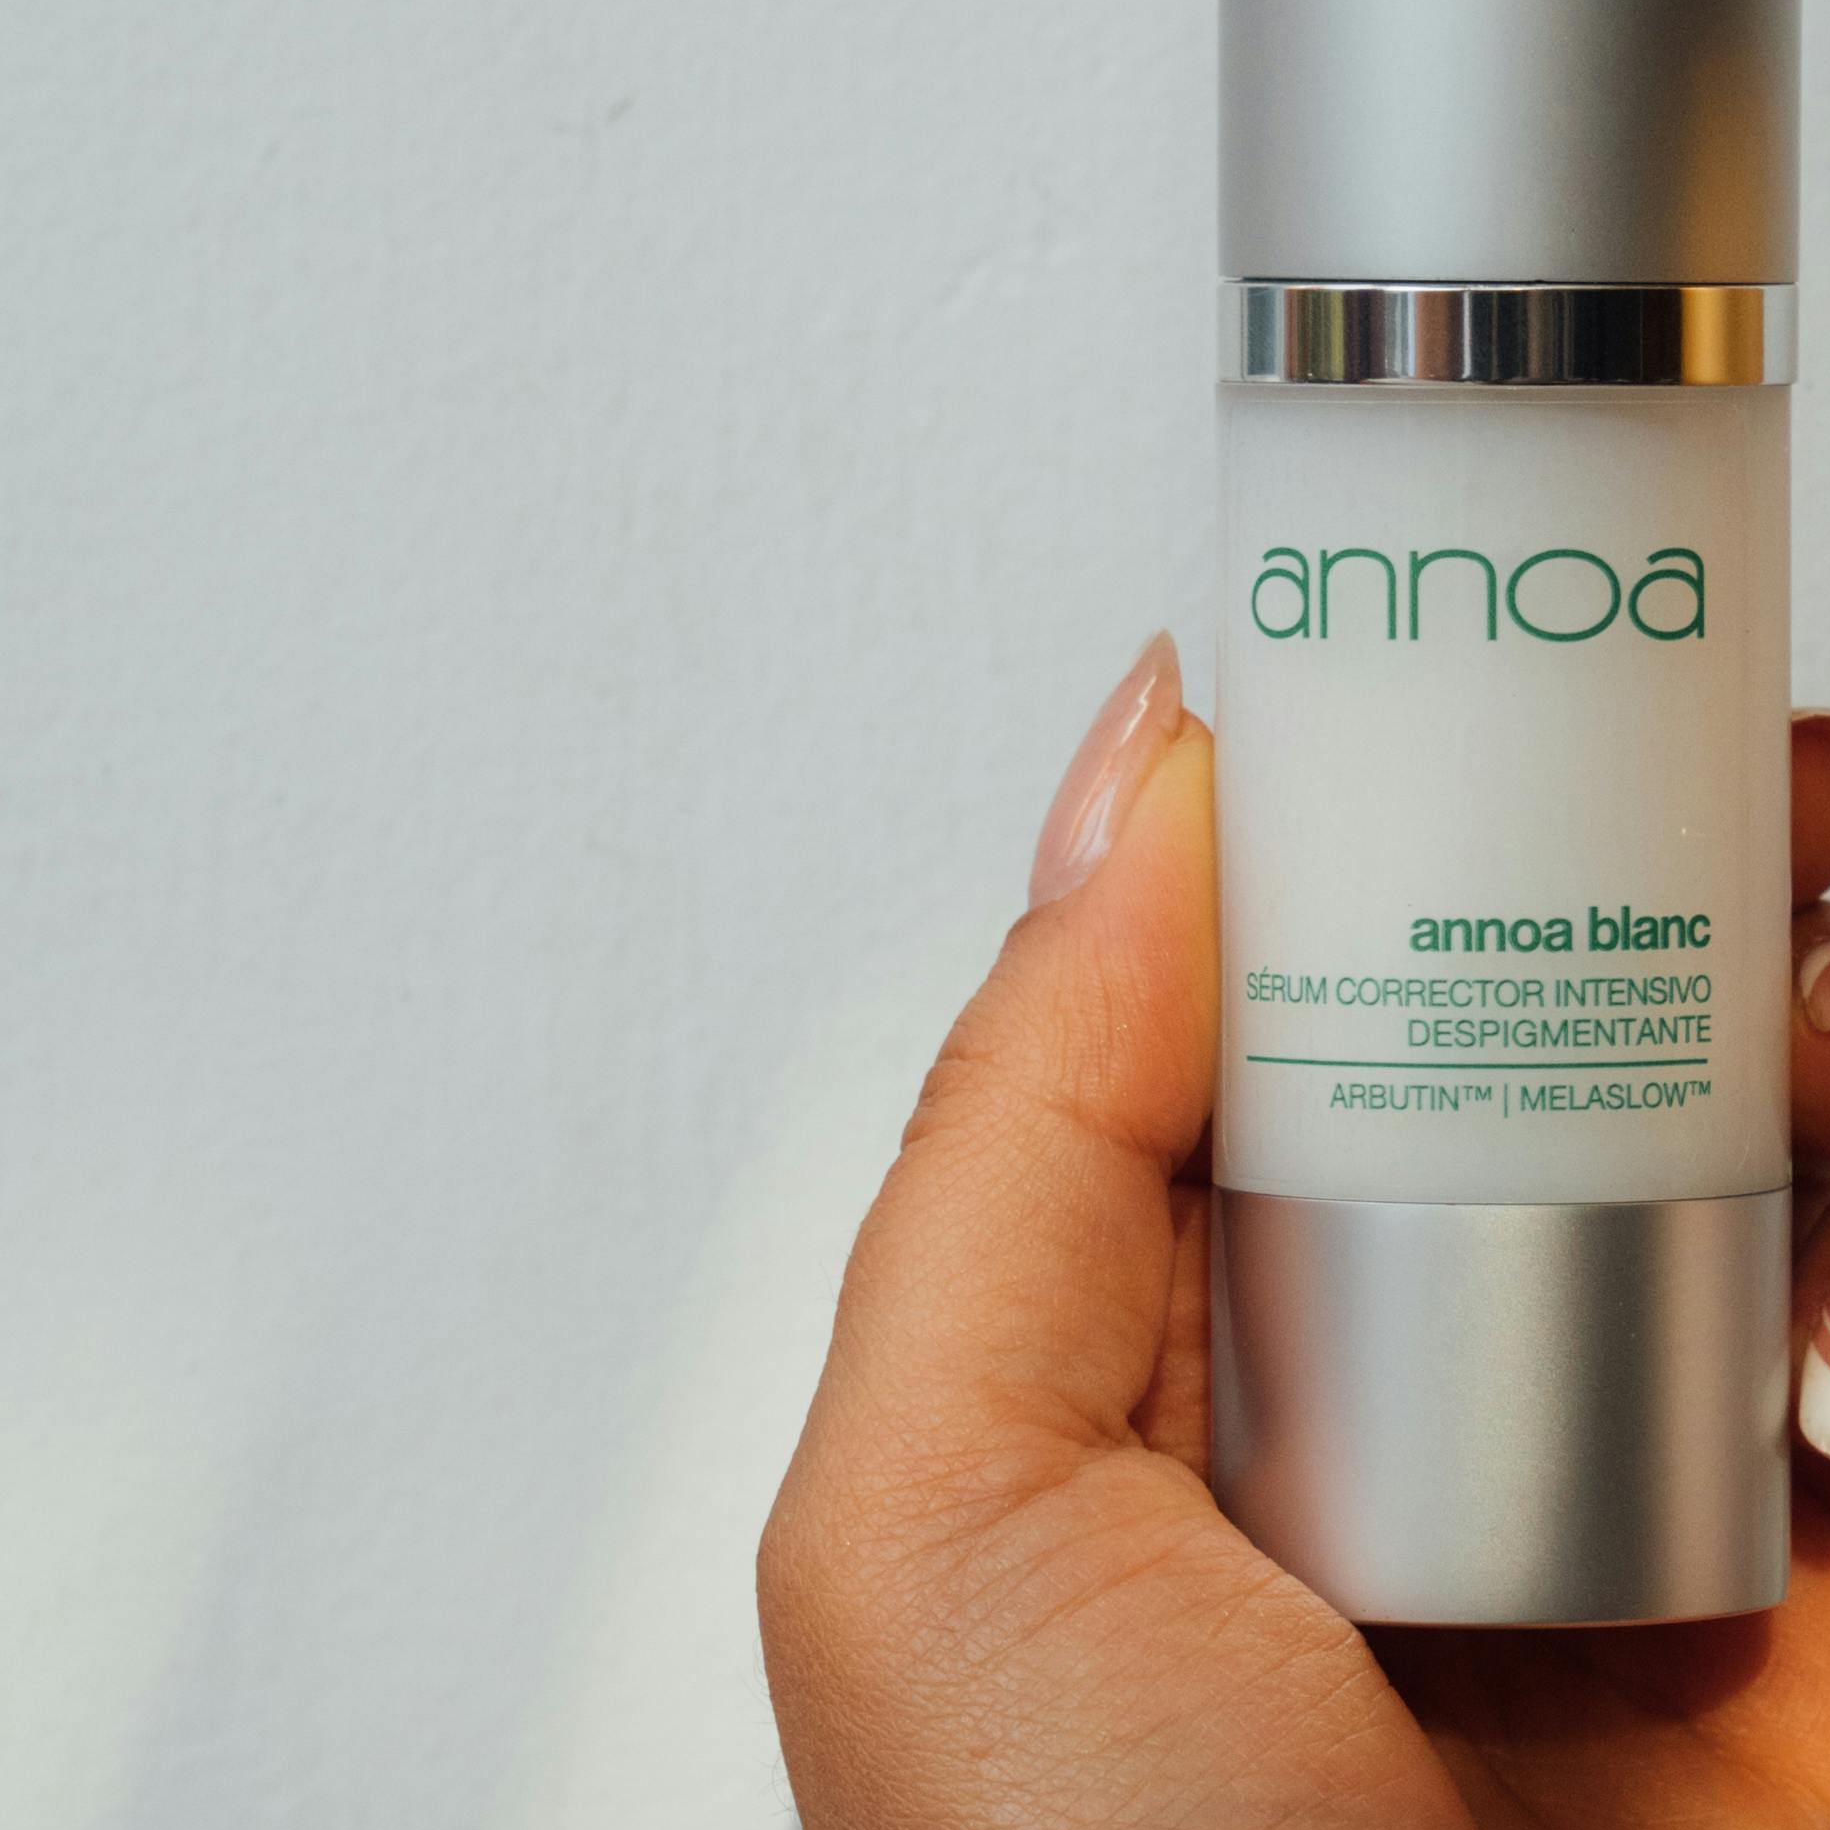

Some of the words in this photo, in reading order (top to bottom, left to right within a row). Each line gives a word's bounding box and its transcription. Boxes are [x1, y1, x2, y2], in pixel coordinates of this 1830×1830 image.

[1251, 547, 1703, 641] annoa
[1409, 916, 1571, 951] annoa
[1588, 906, 1710, 949] blanc
[1246, 966, 1325, 1003] SÉRUM
[1336, 978, 1543, 1007] CORRECTOR
[1554, 974, 1710, 1005] INTENSIVO
[1408, 1016, 1710, 1047] DESPIGMENTANTE
